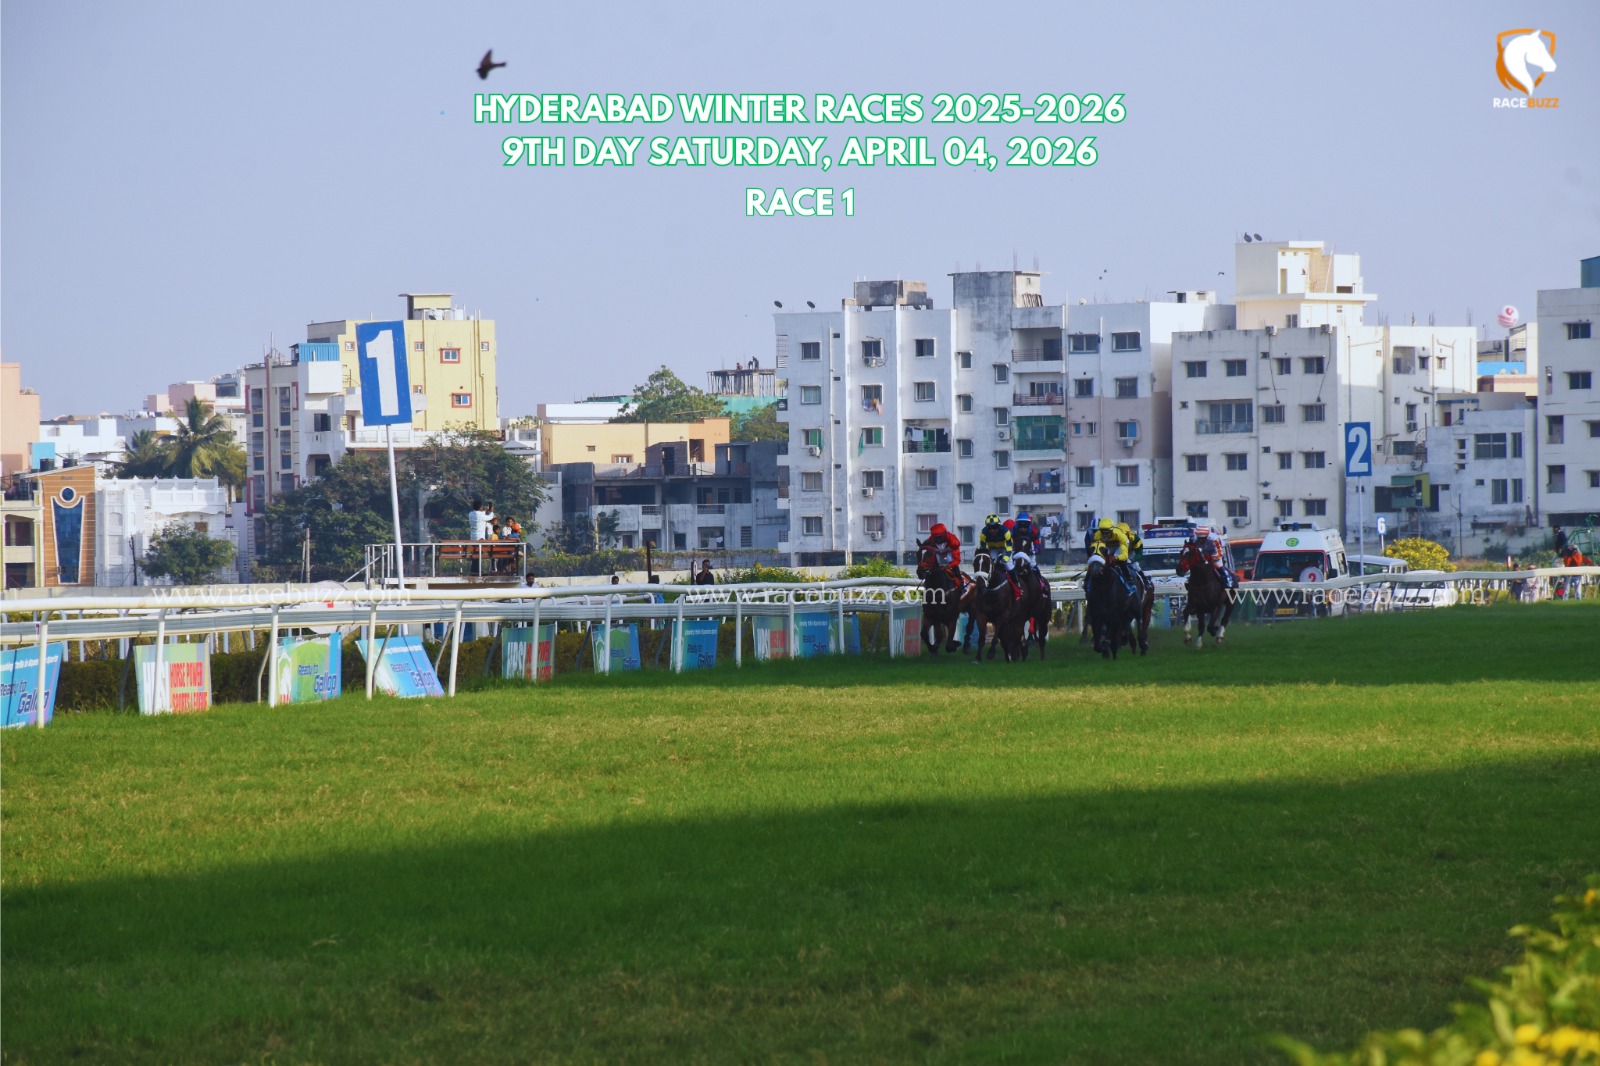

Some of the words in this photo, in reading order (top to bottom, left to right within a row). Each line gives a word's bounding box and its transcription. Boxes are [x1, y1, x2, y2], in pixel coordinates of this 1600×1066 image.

[366, 329, 399, 416] 1
[1348, 426, 1368, 473] 2
[1377, 516, 1386, 534] 6
[170, 662, 186, 689] HORSE
[298, 664, 312, 677] Ready
[313, 671, 337, 694] Gallop
